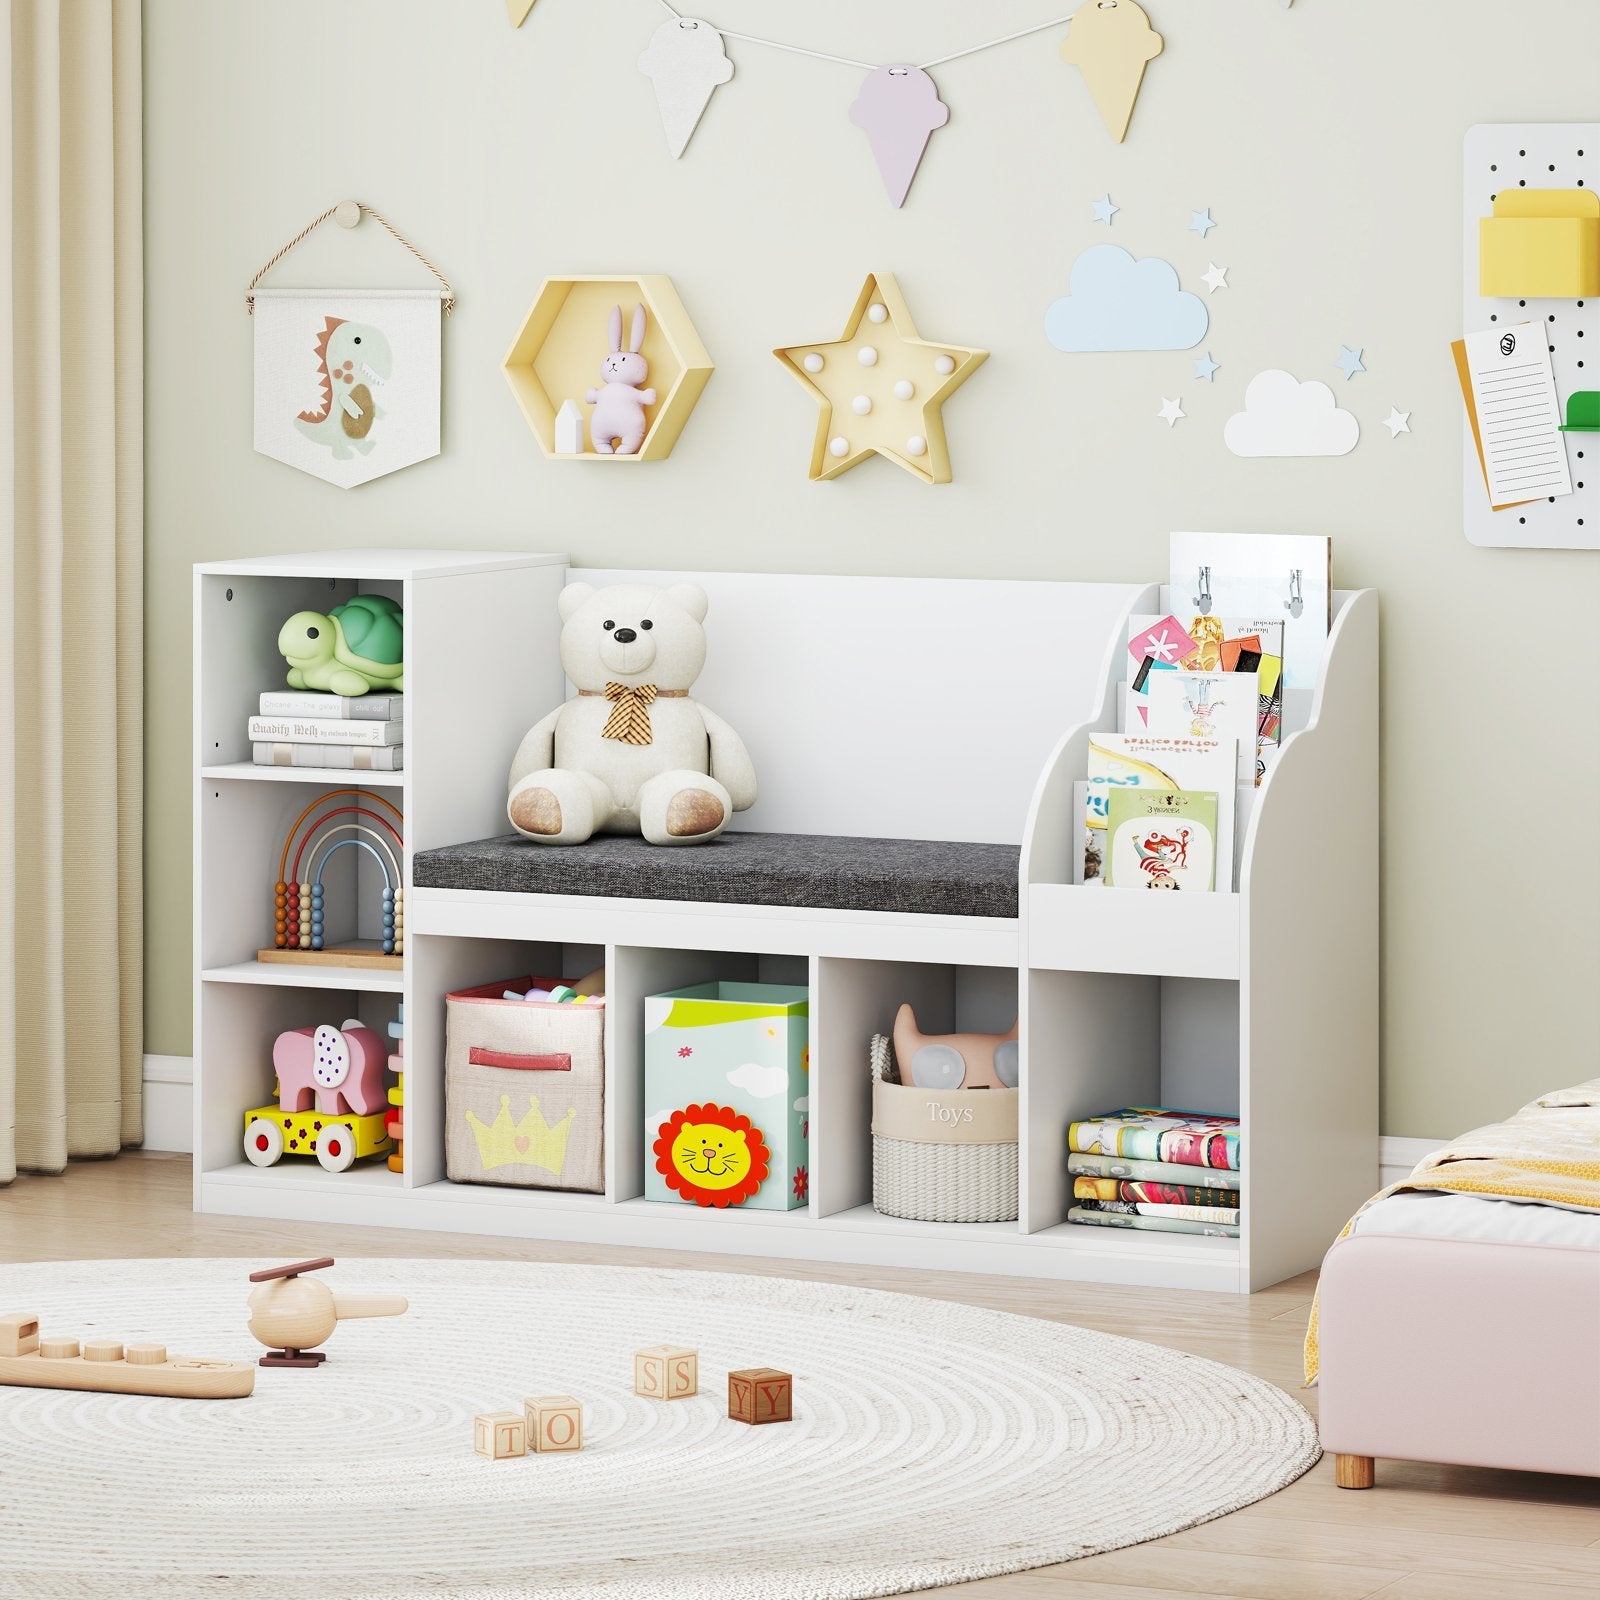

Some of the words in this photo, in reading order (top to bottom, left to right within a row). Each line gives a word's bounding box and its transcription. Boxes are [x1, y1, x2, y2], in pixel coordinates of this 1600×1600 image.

[372, 705, 384, 713] out
[926, 1102, 974, 1128] Toys
[643, 1361, 657, 1392] S
[675, 1361, 690, 1392] S
[732, 1382, 749, 1416] Y
[761, 1384, 786, 1416] Y
[478, 1423, 489, 1450] T
[501, 1426, 520, 1453] T
[546, 1413, 575, 1445] O
